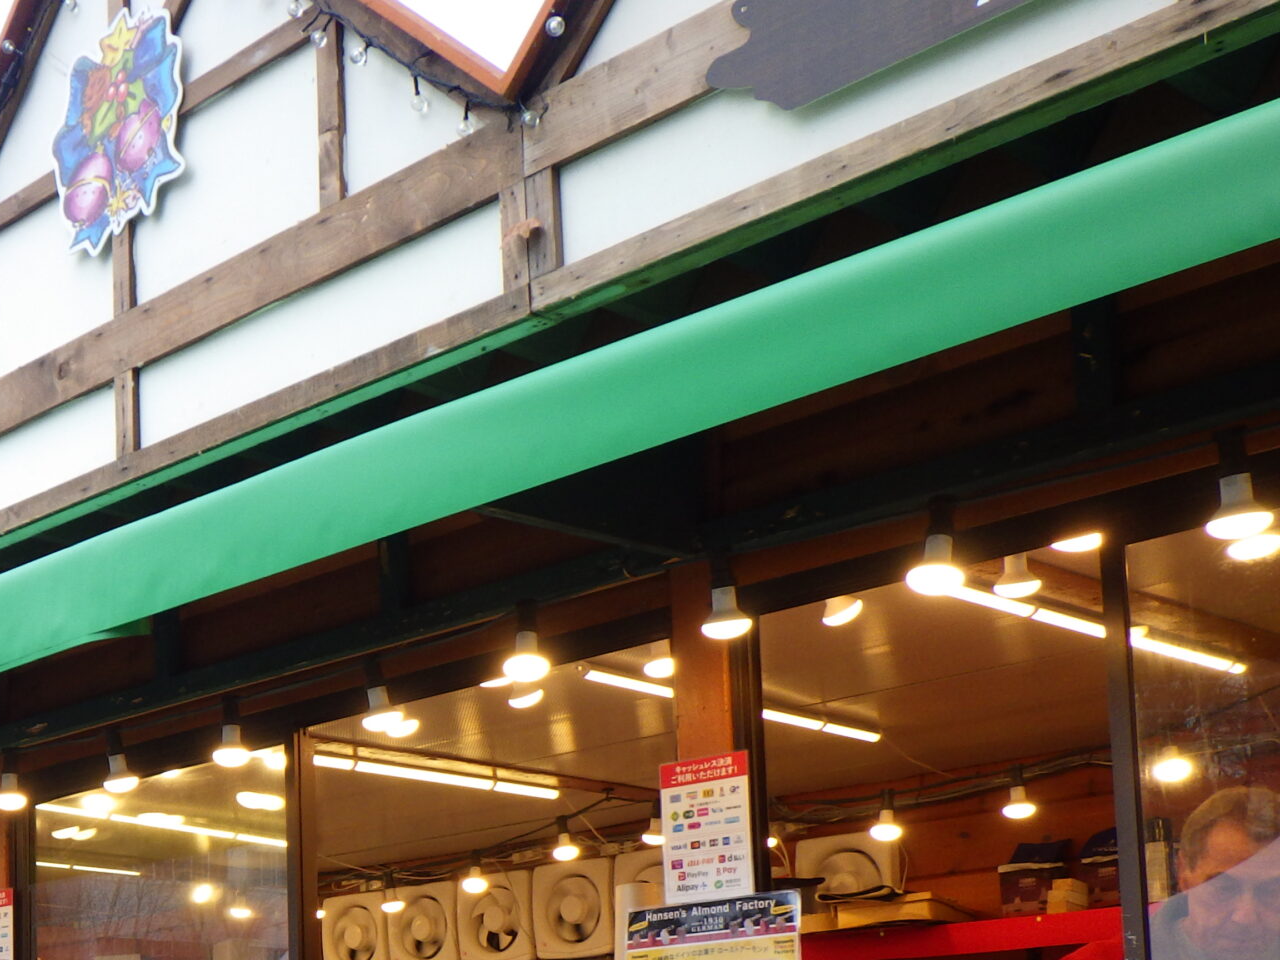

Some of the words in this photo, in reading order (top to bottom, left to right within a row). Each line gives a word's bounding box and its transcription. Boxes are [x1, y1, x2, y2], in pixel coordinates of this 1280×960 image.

[677, 884, 699, 892] Alipay
[646, 908, 688, 923] Hansen's
[692, 902, 730, 916] Almond
[736, 898, 777, 912] Factory
